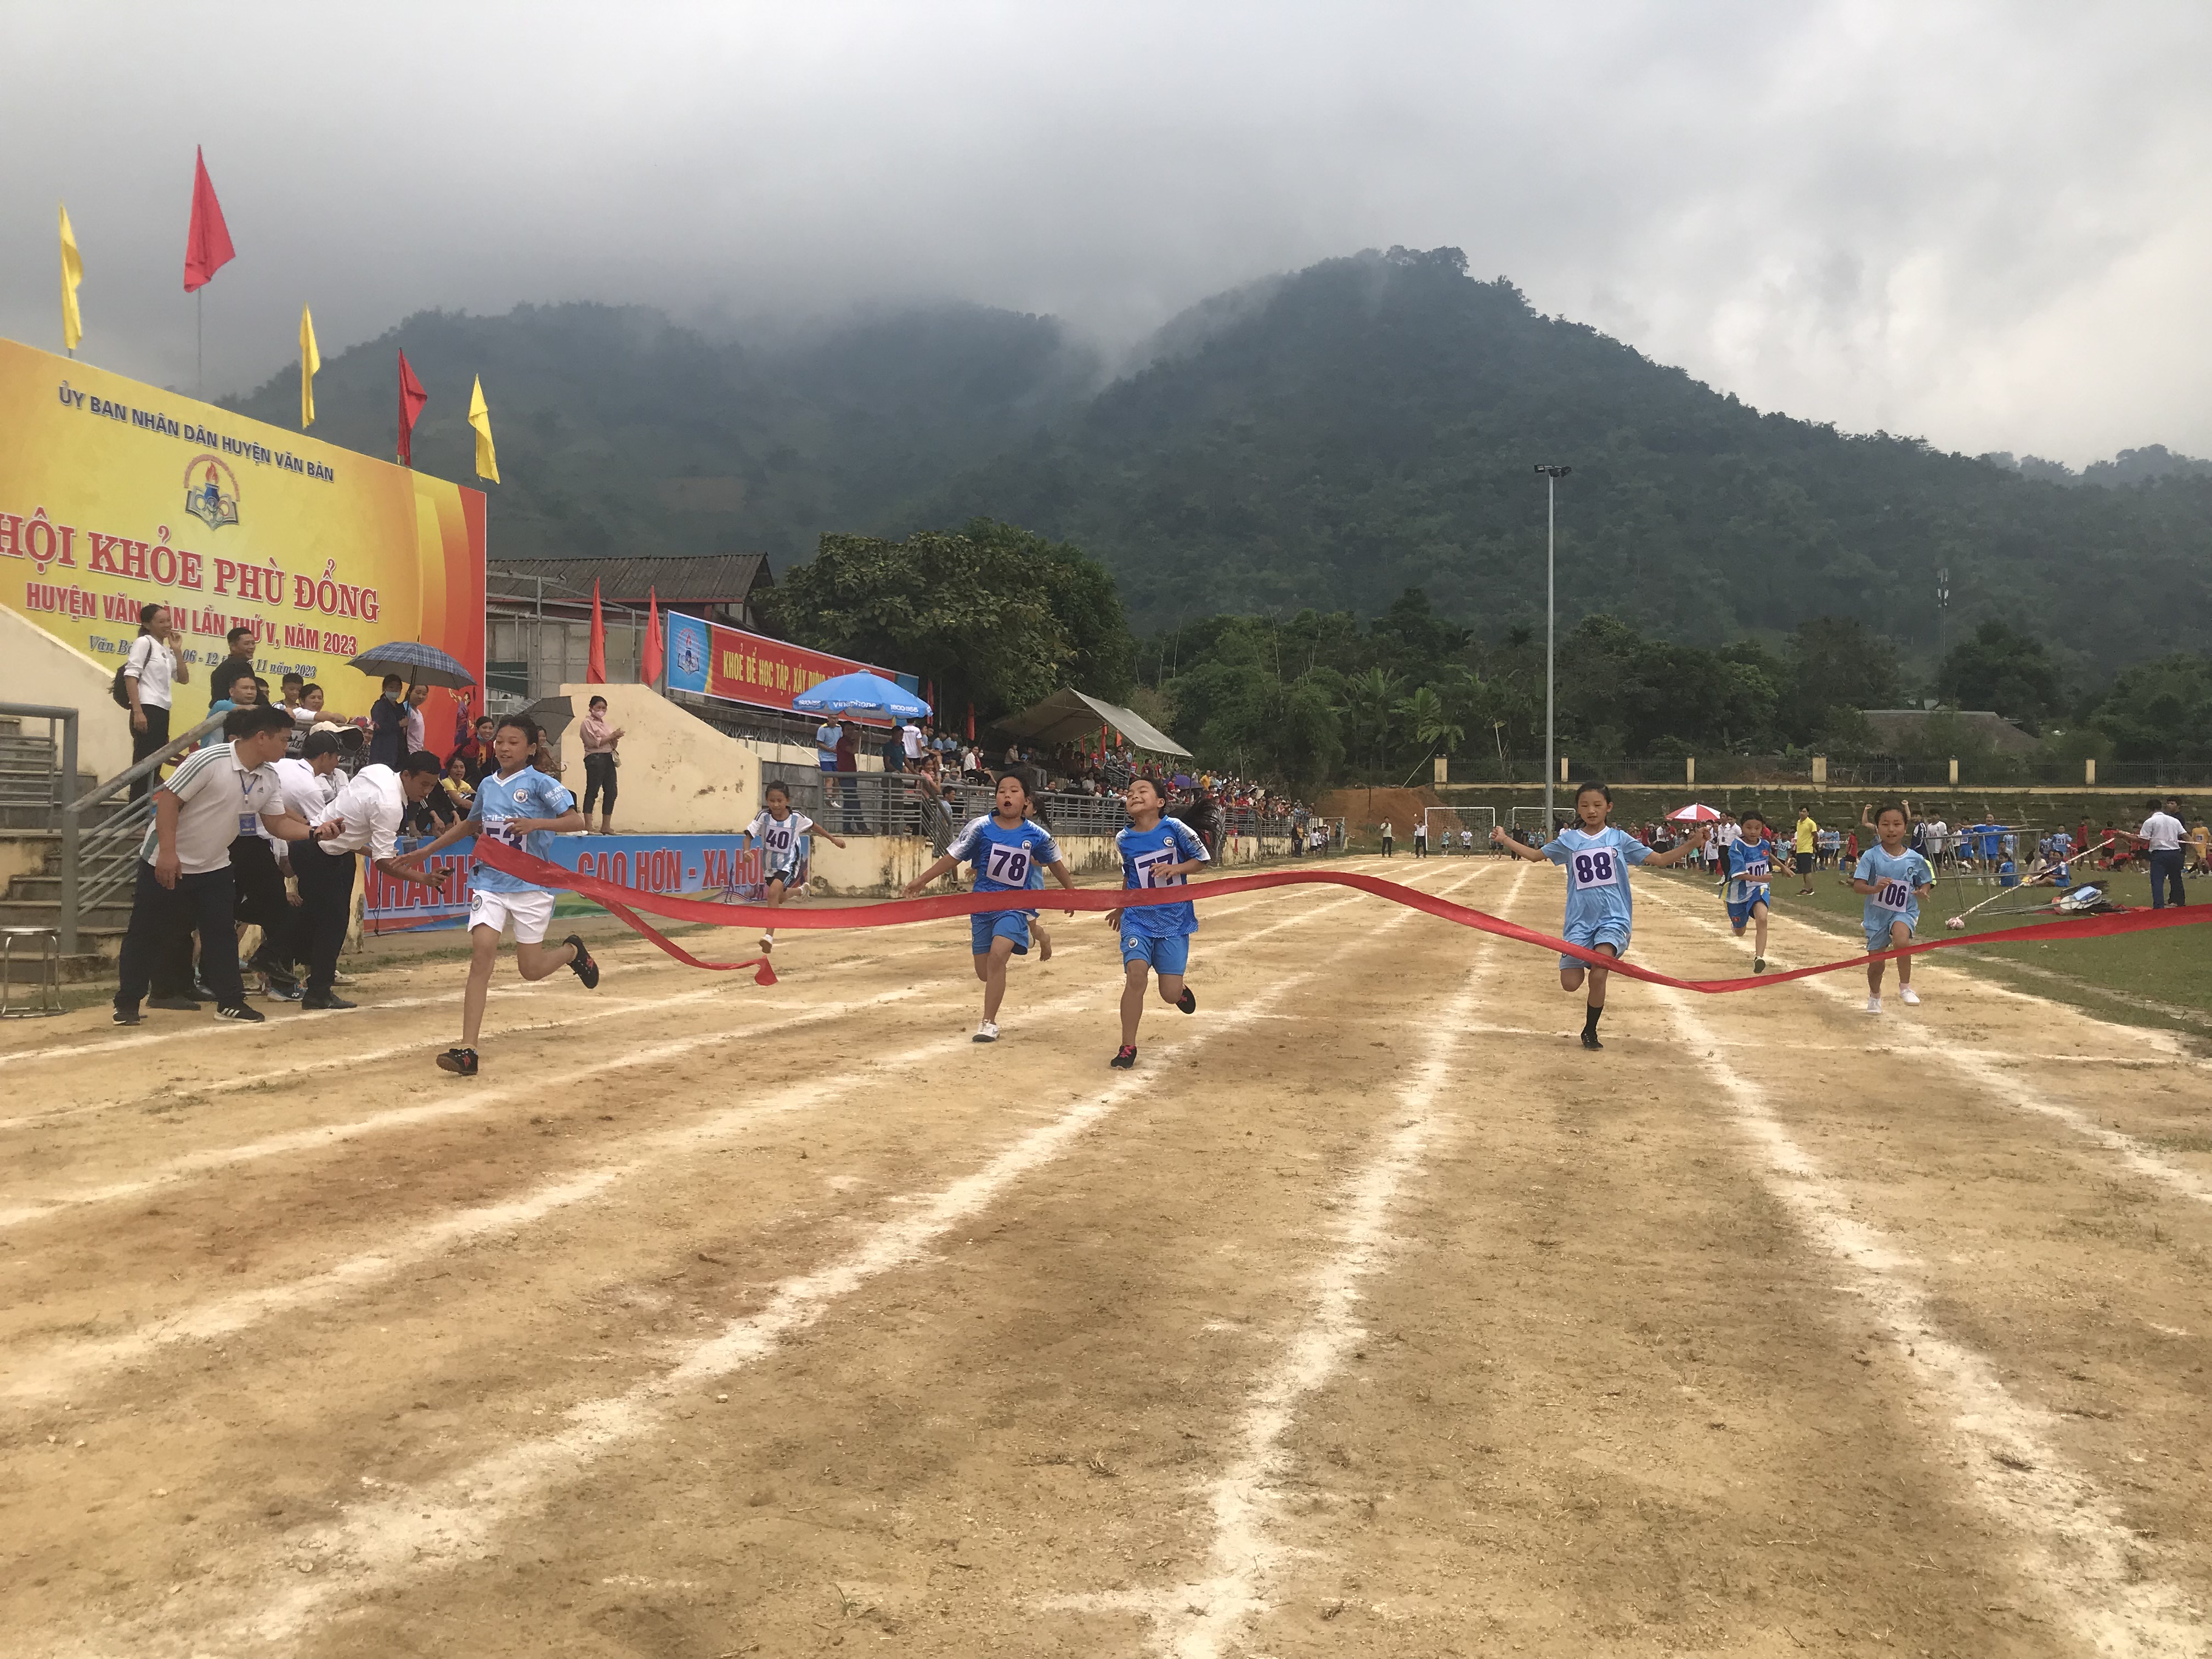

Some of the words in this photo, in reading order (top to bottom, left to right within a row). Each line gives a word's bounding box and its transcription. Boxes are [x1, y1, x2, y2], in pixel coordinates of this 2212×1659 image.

[59, 380, 85, 409] ỦY
[91, 396, 127, 422] BAN
[132, 408, 180, 438] NHÂN
[184, 424, 218, 449] DÂN
[222, 436, 271, 465] HUYỆN
[274, 451, 303, 475] VĂN
[307, 460, 335, 483] BÀN
[0, 505, 77, 574] HỘI
[87, 524, 204, 591] KHỎE
[213, 556, 286, 606] PHÙ
[293, 558, 380, 623] ĐỔNG
[26, 582, 97, 621] HUYỆN
[103, 592, 142, 625] VĂN
[192, 604, 226, 638] LẦN
[266, 622, 281, 648] V,
[285, 623, 319, 652] NĂM
[323, 631, 357, 657] 2023
[89, 635, 114, 653] Văn
[183, 648, 197, 663] 06
[205, 652, 218, 667] 12
[255, 658, 268, 673] 11
[269, 662, 292, 675] năm
[295, 663, 317, 679] 2023
[759, 659, 774, 692] HỌC
[793, 663, 807, 693] XÂY
[833, 700, 877, 708] vinaphone
[544, 785, 566, 799] NEXEN
[551, 792, 566, 802] TIRE
[766, 829, 790, 850] 40
[577, 850, 628, 887] CAO
[635, 847, 682, 893] HƠN
[702, 849, 729, 889] XA
[992, 849, 1026, 881] 78
[1575, 851, 1612, 883] 88
[1748, 864, 1765, 882] 107
[1878, 883, 1907, 907] 106
